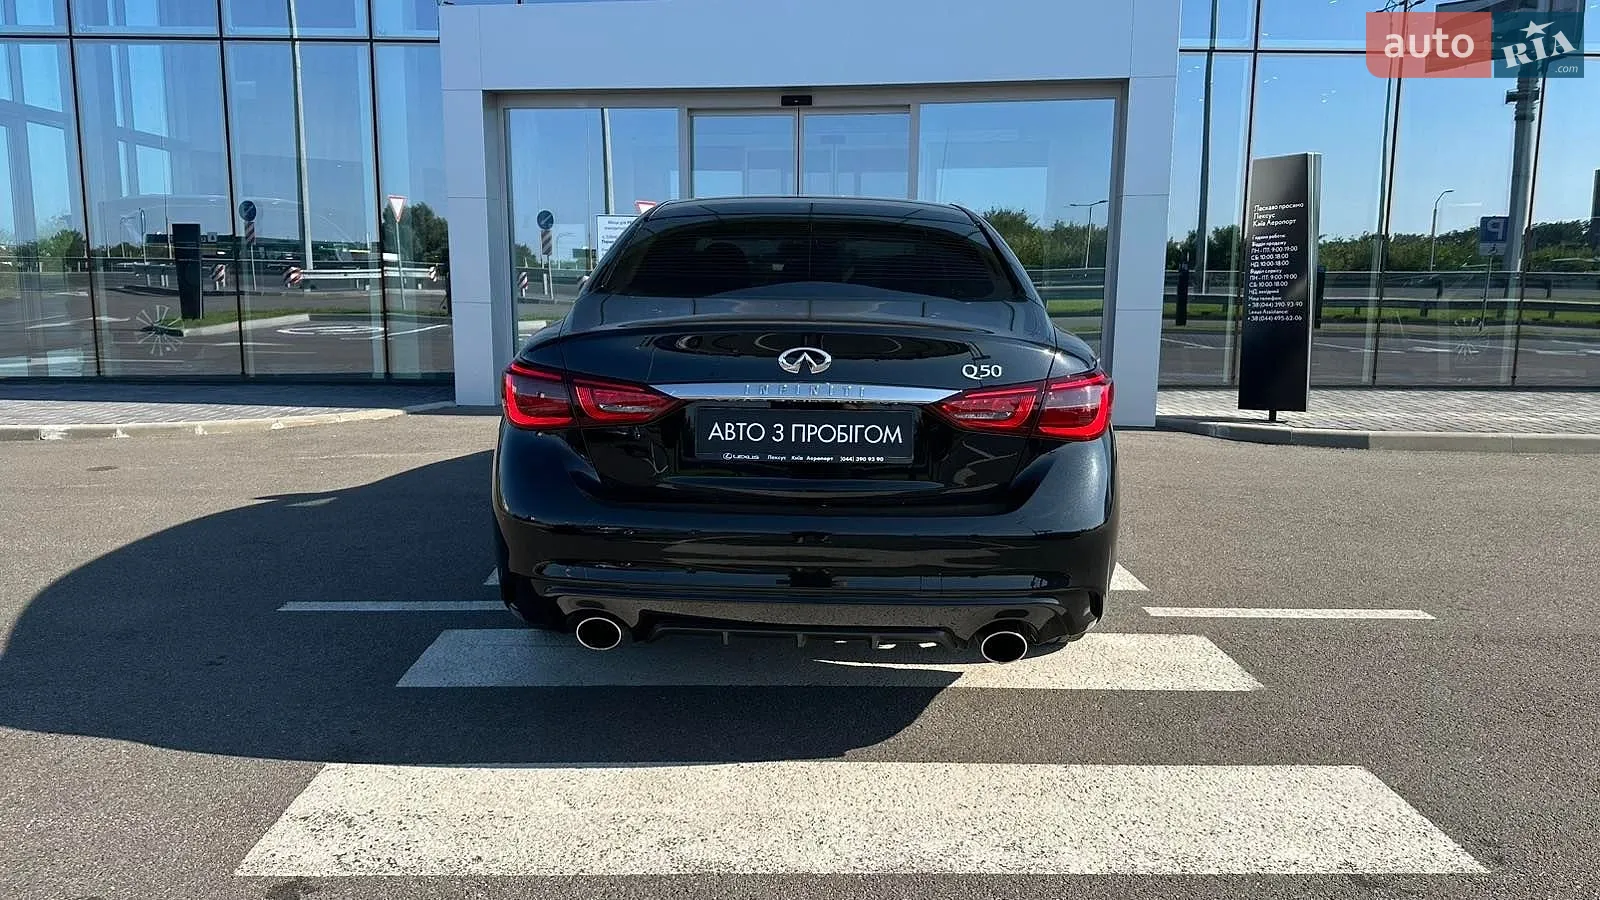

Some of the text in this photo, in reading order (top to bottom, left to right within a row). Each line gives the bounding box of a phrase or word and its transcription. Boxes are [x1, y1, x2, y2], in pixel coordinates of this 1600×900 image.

[1279, 203, 1304, 211] просимо
[1253, 219, 1297, 228] Київ Аеропорт
[961, 364, 1003, 380] Q50
[744, 383, 865, 397] INFINITI
[708, 421, 766, 442] АВТО
[791, 423, 903, 444] ПРОБІГОМ
